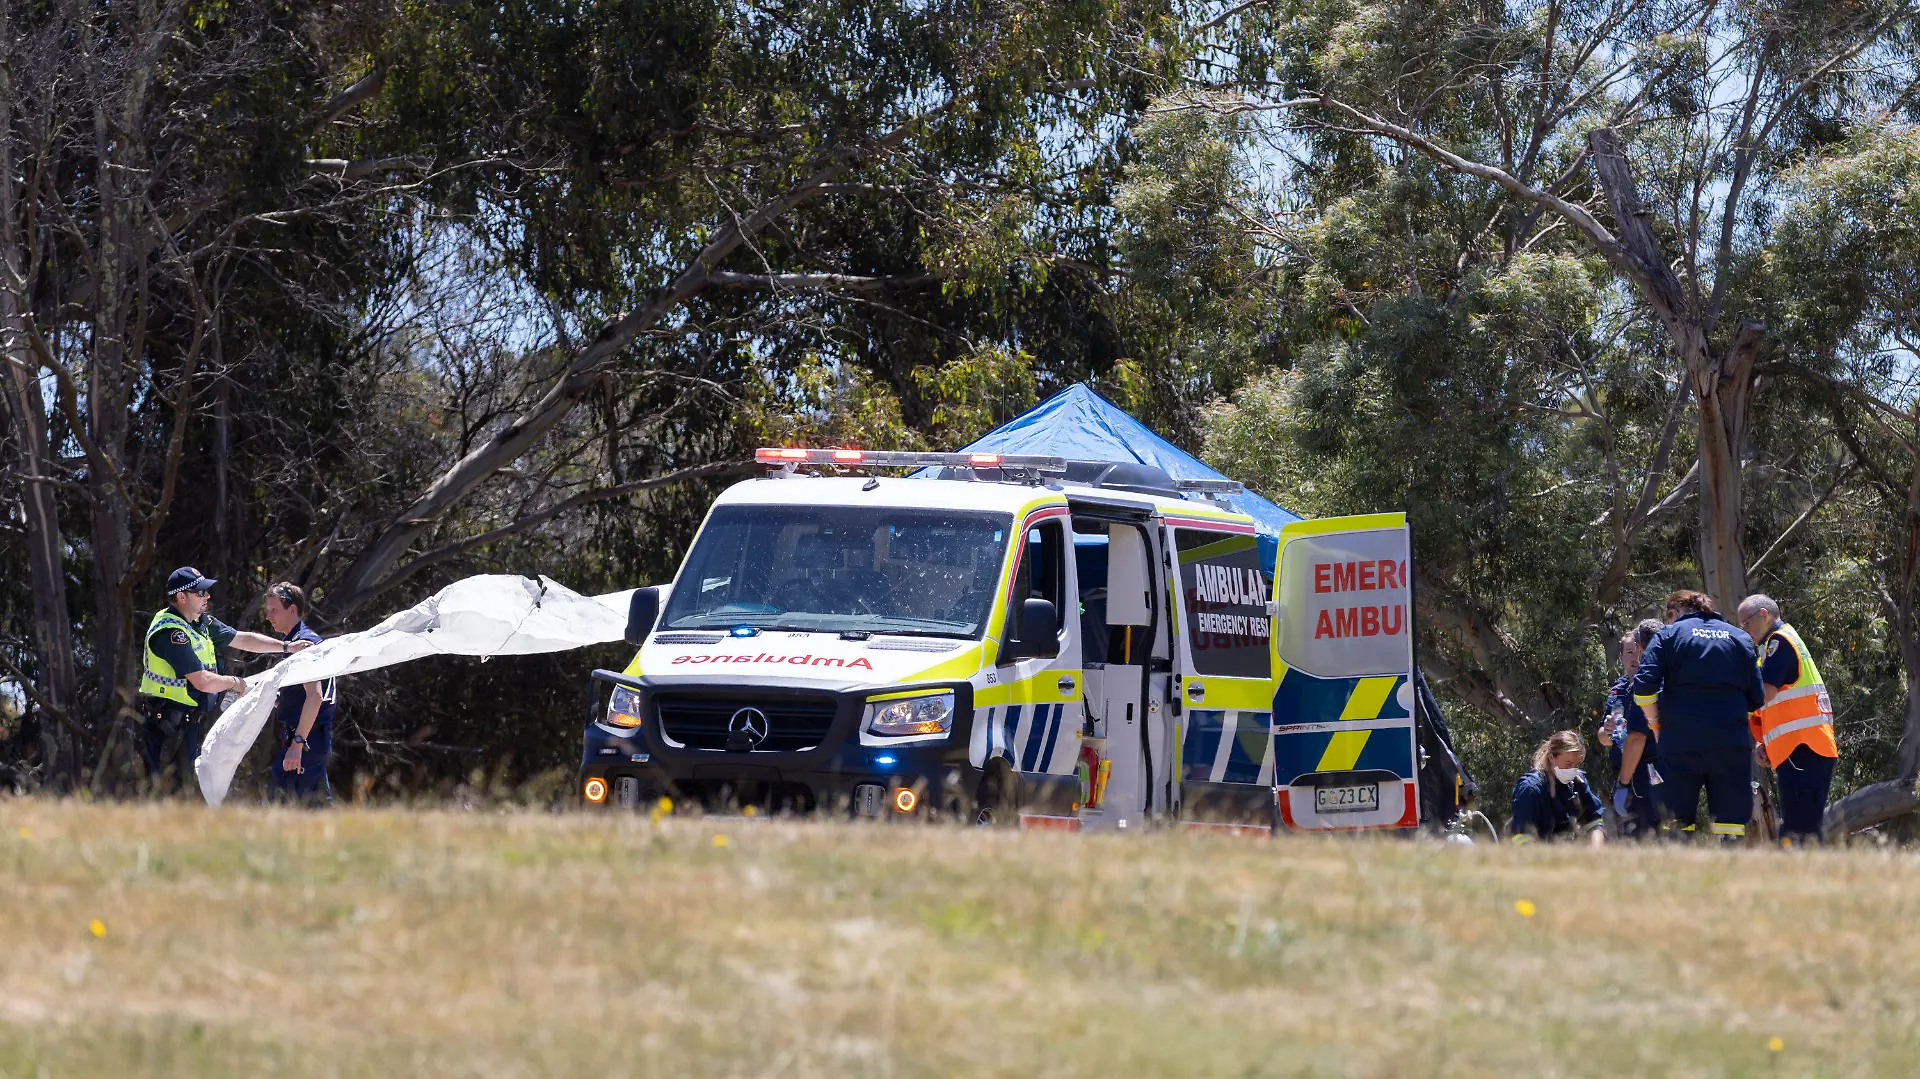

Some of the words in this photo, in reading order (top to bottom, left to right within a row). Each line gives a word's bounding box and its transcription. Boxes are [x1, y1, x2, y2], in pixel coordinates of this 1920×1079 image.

[1198, 612, 1248, 636] EMERGENCY
[1314, 604, 1408, 639] AMBU
[1692, 628, 1730, 639] DOCTOR
[986, 672, 997, 684] 853
